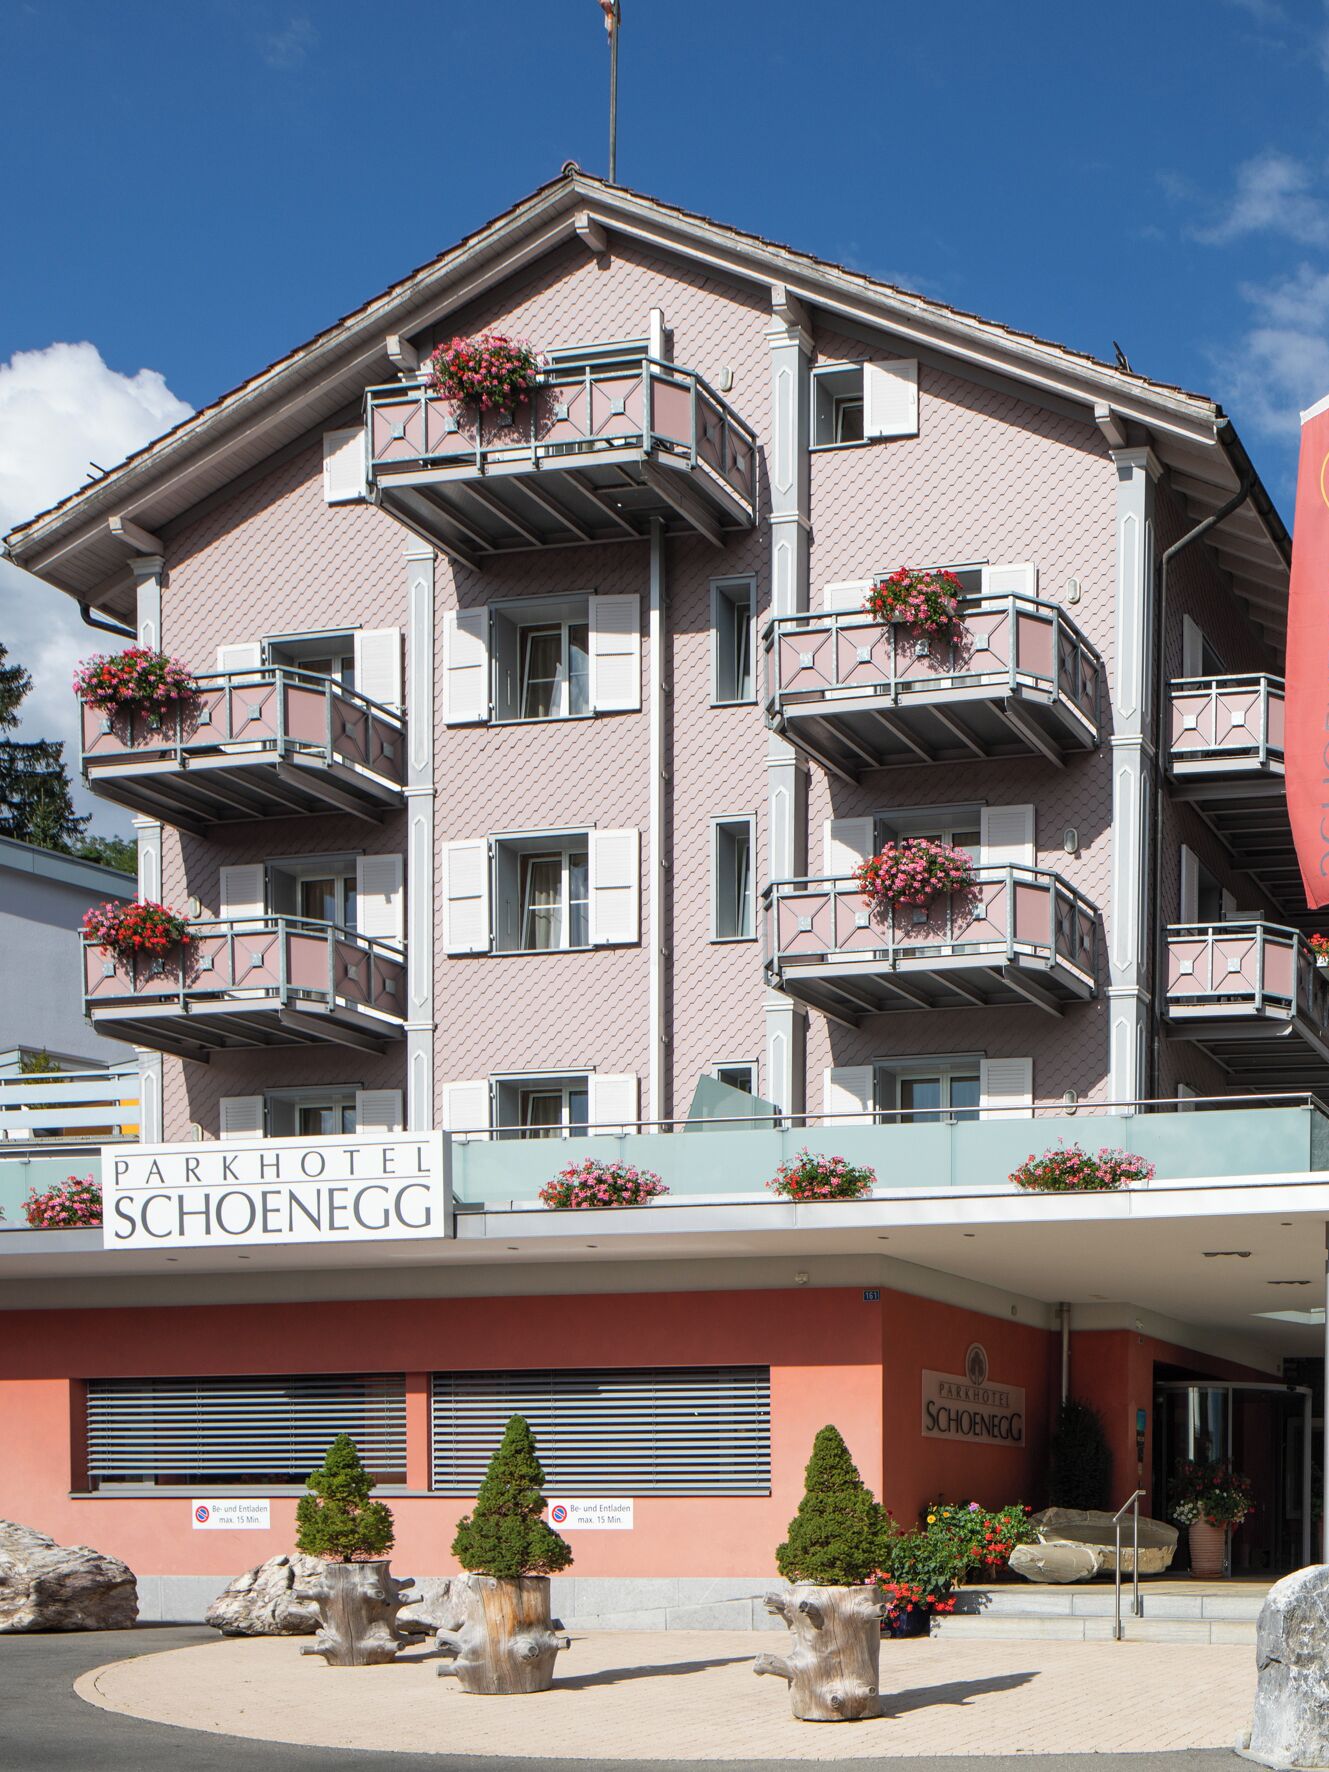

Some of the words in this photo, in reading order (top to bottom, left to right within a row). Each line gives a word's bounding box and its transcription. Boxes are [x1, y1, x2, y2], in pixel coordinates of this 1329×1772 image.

[114, 1146, 431, 1186] PARKHOTEL
[114, 1183, 432, 1240] SCHOENEGG
[865, 1291, 877, 1300] 161
[939, 1383, 1009, 1408] PARKHOTEL
[926, 1400, 1022, 1442] SCHOENEGG
[212, 1504, 222, 1513] Be-
[224, 1504, 237, 1513] und
[238, 1504, 268, 1513] Entladen
[570, 1504, 581, 1512] Be-
[583, 1504, 597, 1512] und
[599, 1504, 631, 1512] Entladen
[237, 1516, 245, 1524] 15
[246, 1516, 261, 1524] Min.
[597, 1516, 605, 1524] 15
[607, 1516, 623, 1524] Min.
